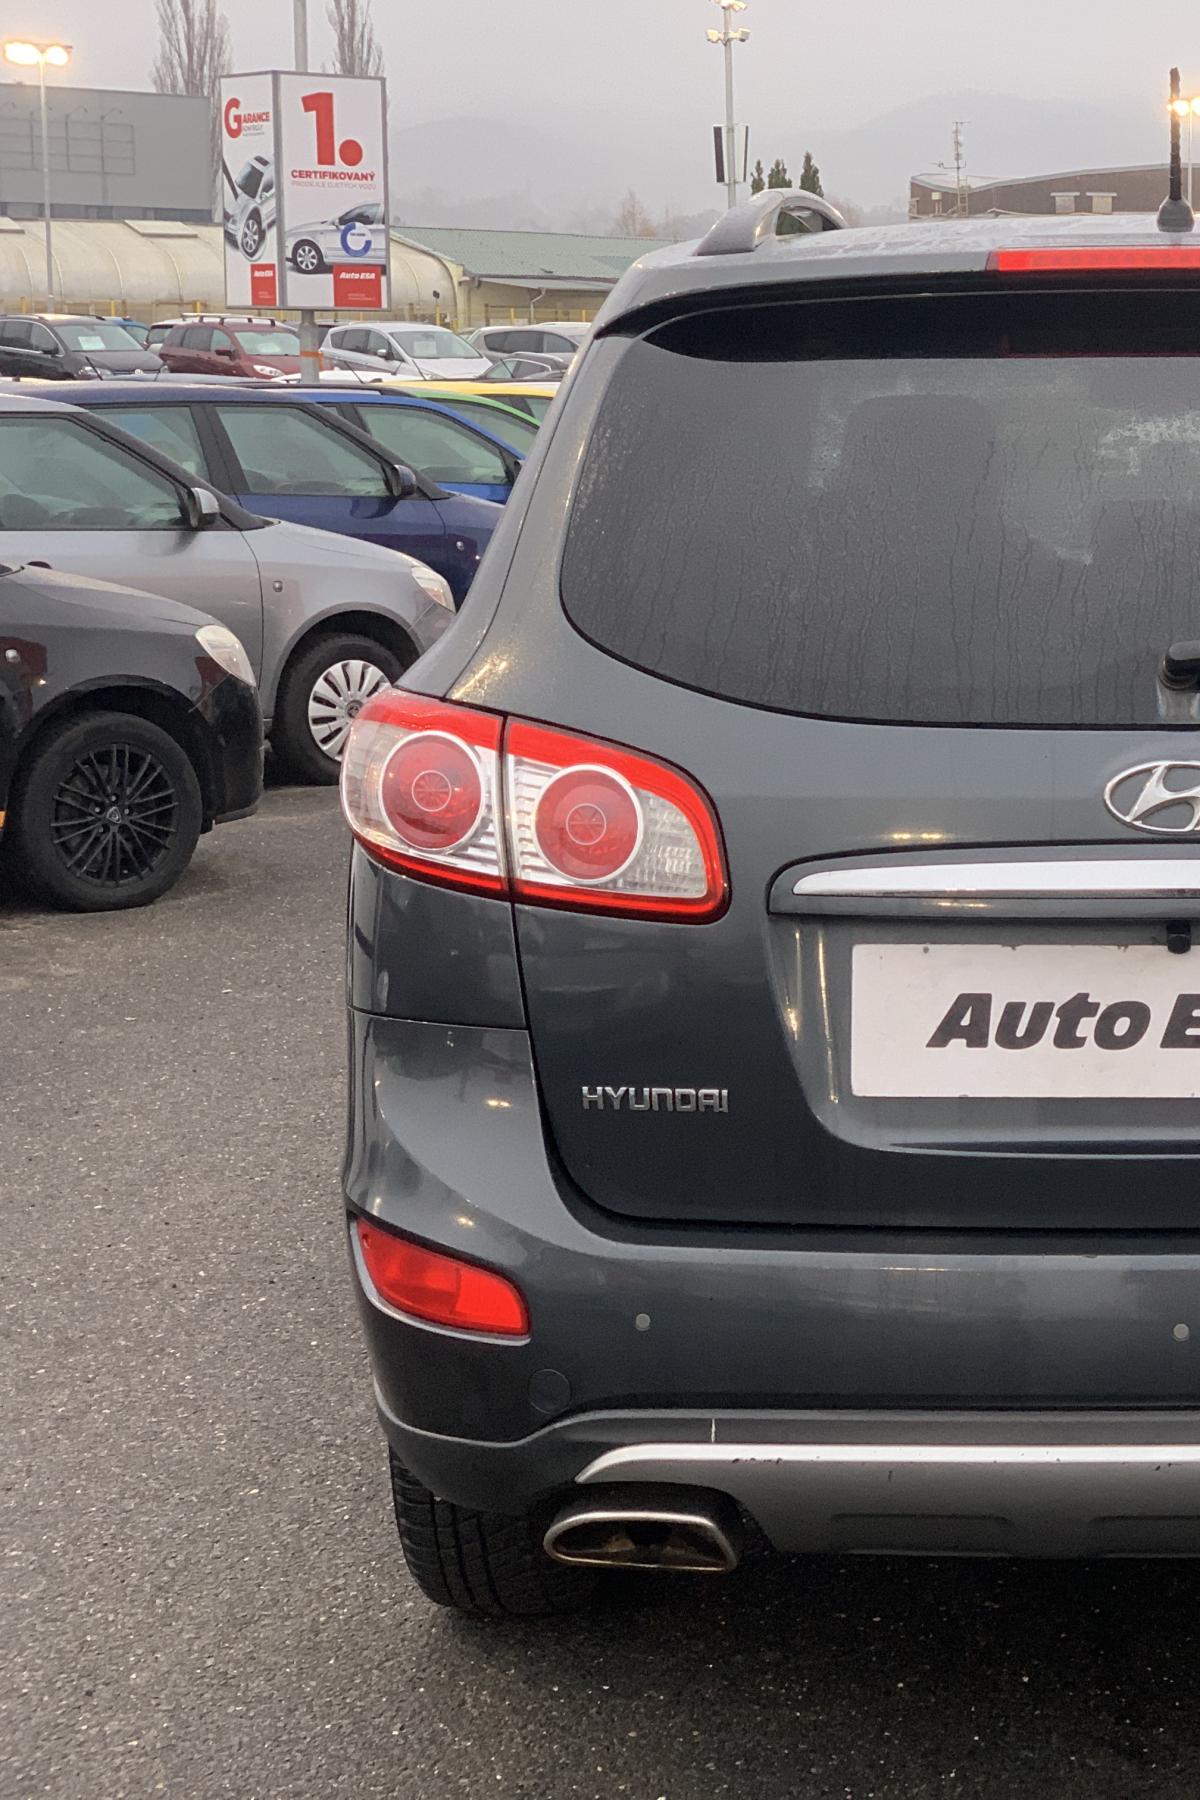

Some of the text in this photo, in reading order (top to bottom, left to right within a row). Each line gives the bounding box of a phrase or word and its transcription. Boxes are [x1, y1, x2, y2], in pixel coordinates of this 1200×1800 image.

[301, 91, 363, 166] 1.
[291, 170, 376, 182] CERTIFIKOVANÝ
[340, 271, 359, 279] Auto
[925, 992, 1152, 1050] Auto
[581, 1086, 729, 1113] HYUNDAI
